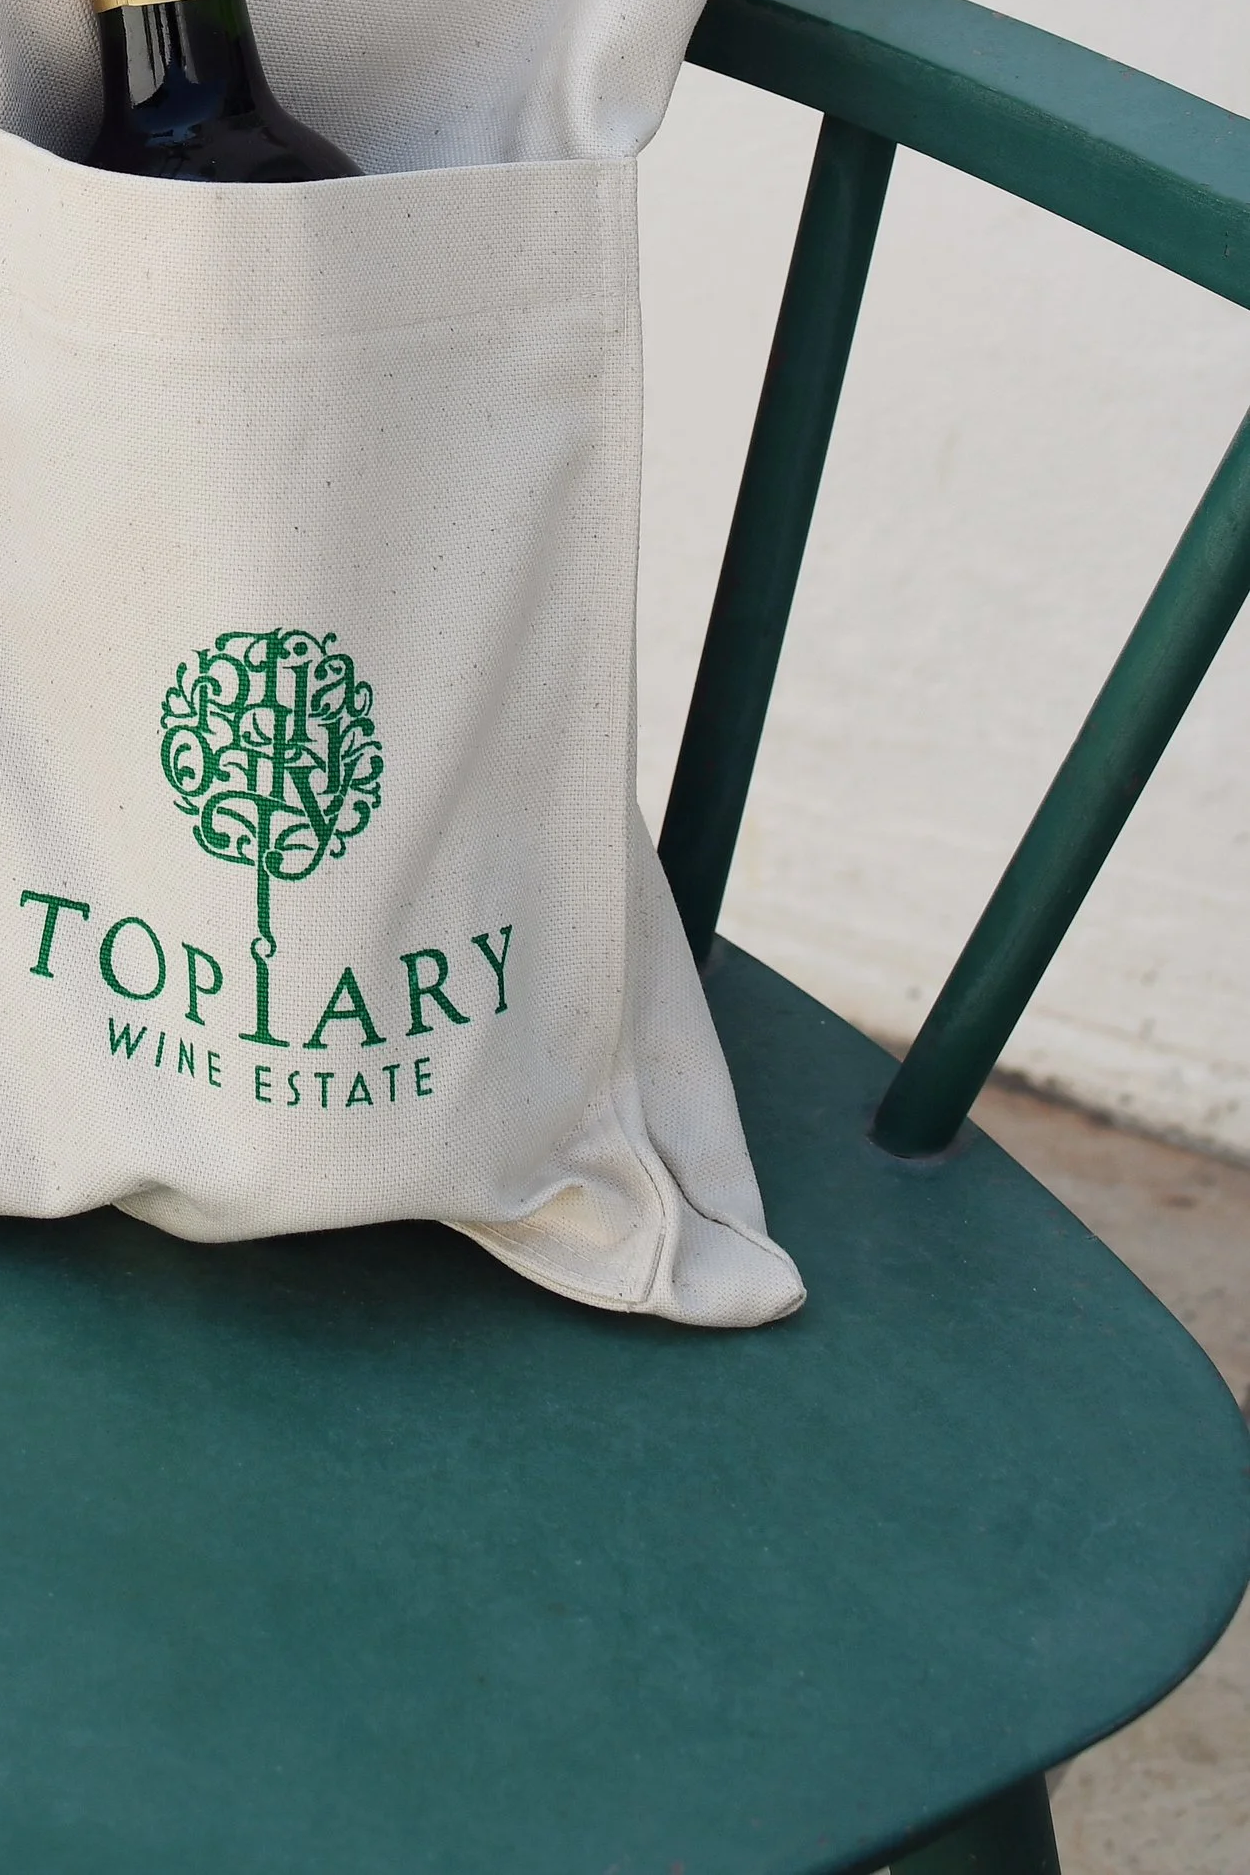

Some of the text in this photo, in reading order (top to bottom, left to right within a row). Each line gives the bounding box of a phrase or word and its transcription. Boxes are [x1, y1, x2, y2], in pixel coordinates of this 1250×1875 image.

[20, 890, 513, 1050] TOPIARY
[108, 1017, 434, 1109] WINE ESTATE
